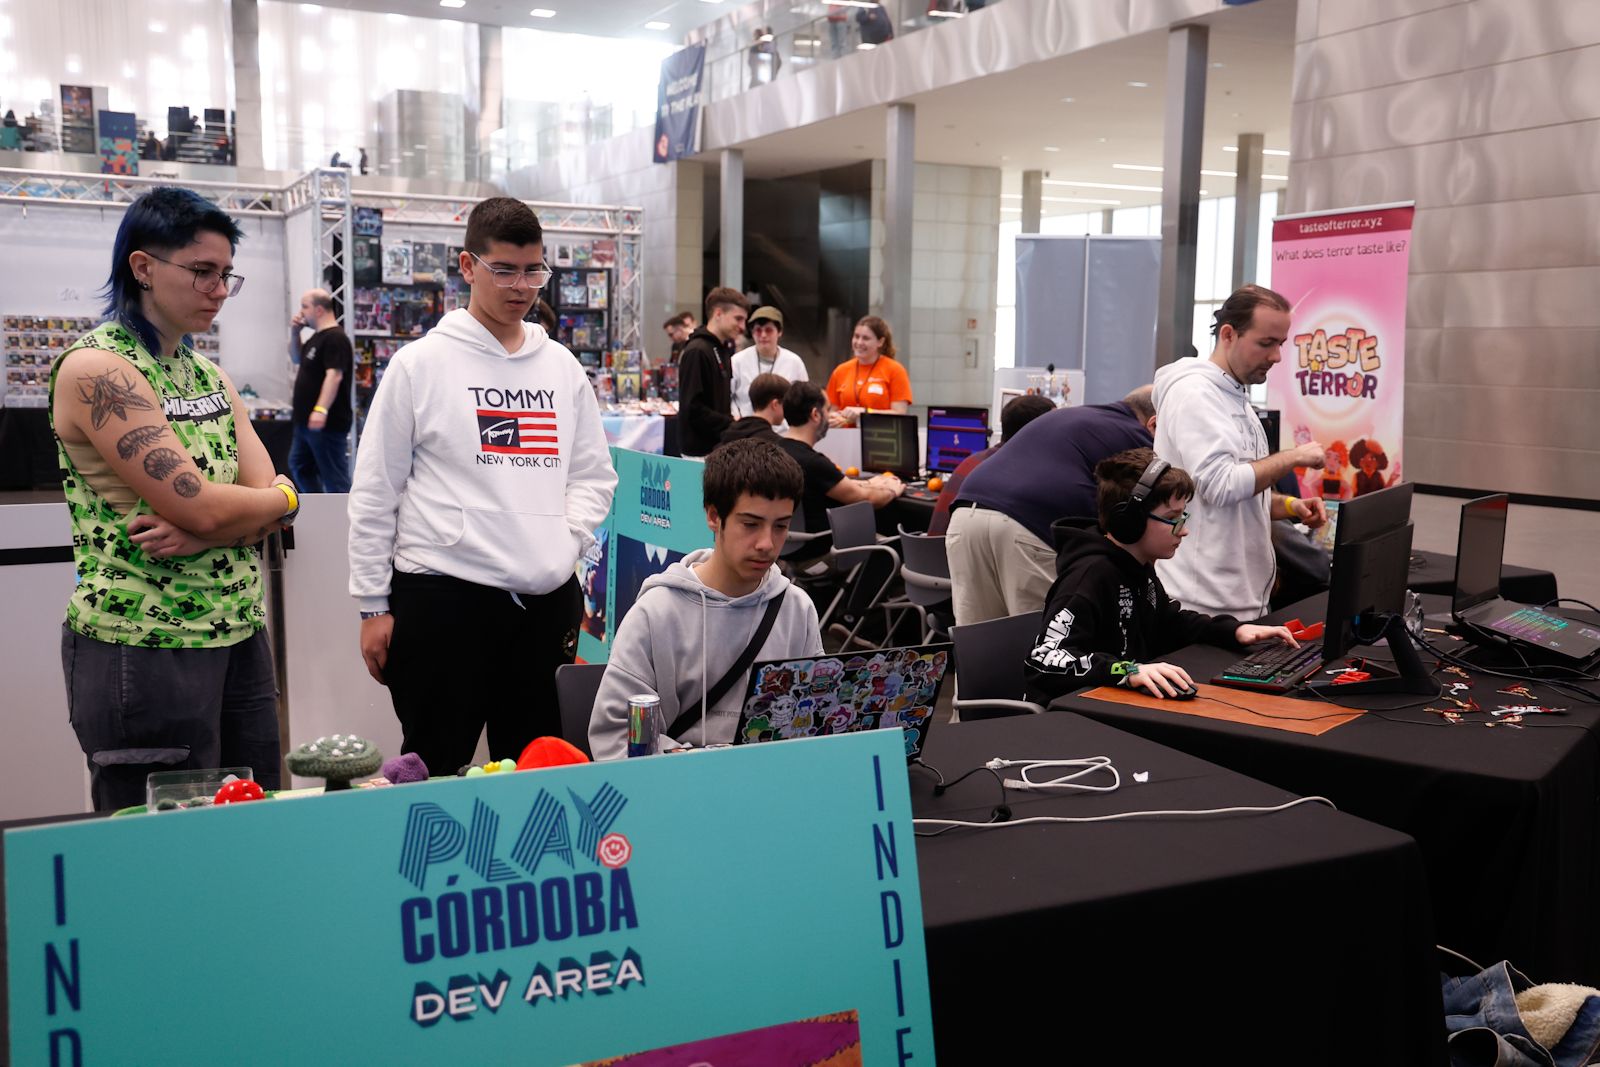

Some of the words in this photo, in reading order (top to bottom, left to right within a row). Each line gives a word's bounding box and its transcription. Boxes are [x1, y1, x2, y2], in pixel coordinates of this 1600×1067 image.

[1299, 217, 1383, 234] tasteofterror.xyz
[1276, 249, 1300, 261] What
[1302, 247, 1324, 259] does
[1327, 245, 1355, 258] terror
[1357, 242, 1384, 255] taste
[1385, 240, 1407, 253] like?
[1294, 327, 1381, 372] TASTE
[467, 387, 554, 409] TOMMY
[1295, 370, 1377, 399] TERROR
[476, 454, 504, 465] NEW
[508, 456, 541, 468] YORK
[543, 457, 562, 468] CIT
[641, 458, 671, 488] PLAY
[398, 781, 629, 892] PLAY
[400, 867, 639, 965] CÓRDOBA
[872, 754, 914, 1067] INDIE
[411, 970, 512, 1027] DEV
[523, 948, 646, 1006] AREA
